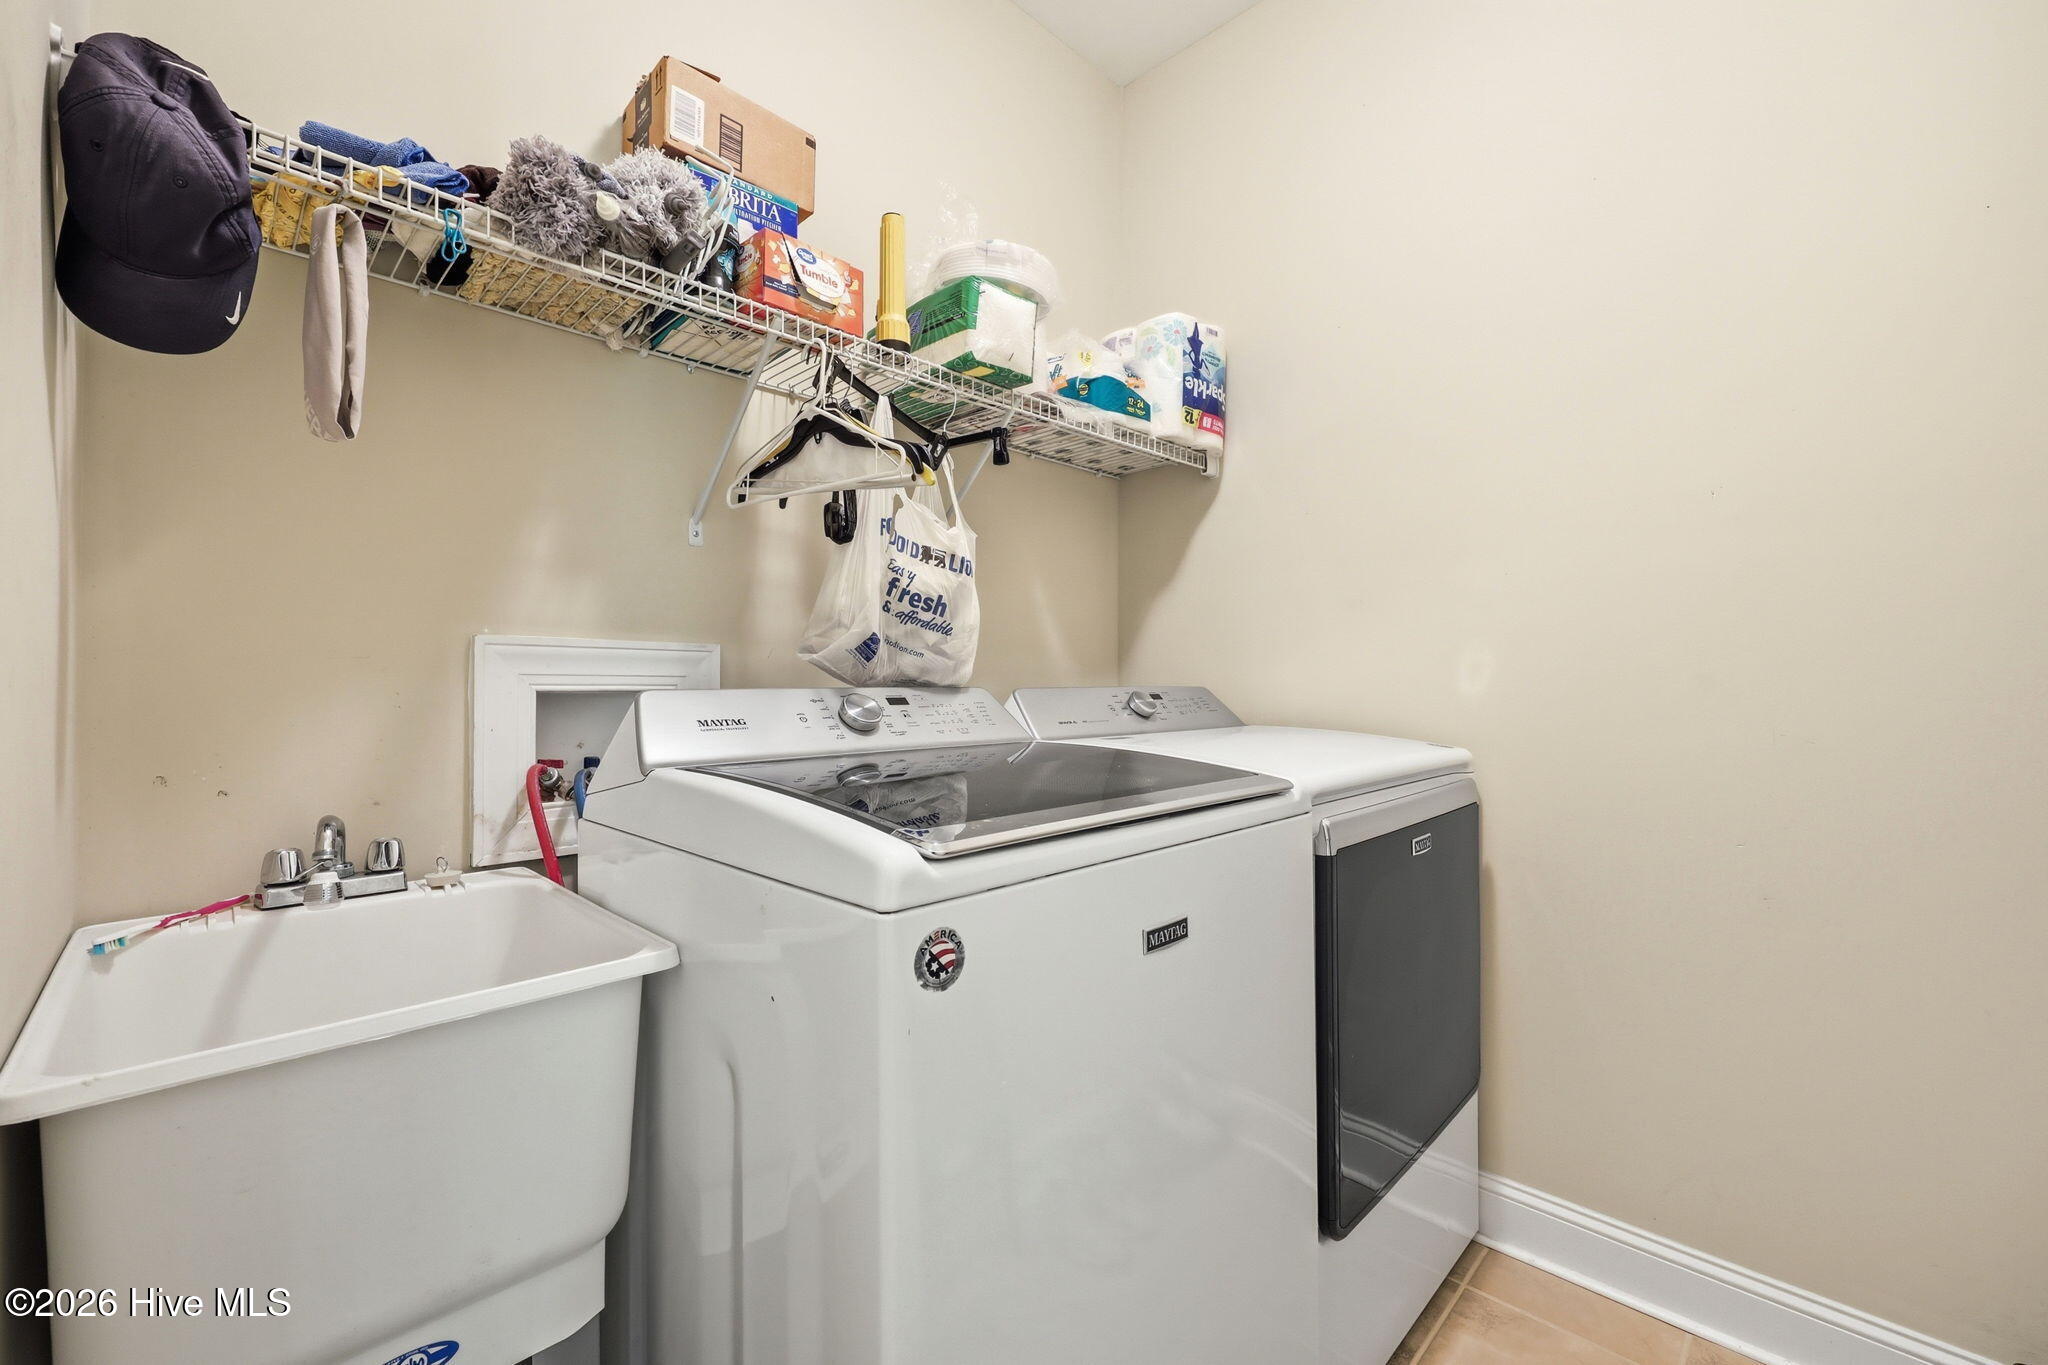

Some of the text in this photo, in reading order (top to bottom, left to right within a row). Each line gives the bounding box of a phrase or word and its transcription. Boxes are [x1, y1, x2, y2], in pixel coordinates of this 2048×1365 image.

[729, 187, 782, 223] BRITA
[800, 264, 839, 289] Tumble
[882, 600, 892, 614] &
[886, 576, 948, 618] fresh
[697, 718, 747, 728] MAYTAG
[920, 929, 962, 957] AMERICA
[1148, 922, 1187, 948] MAYTAG
